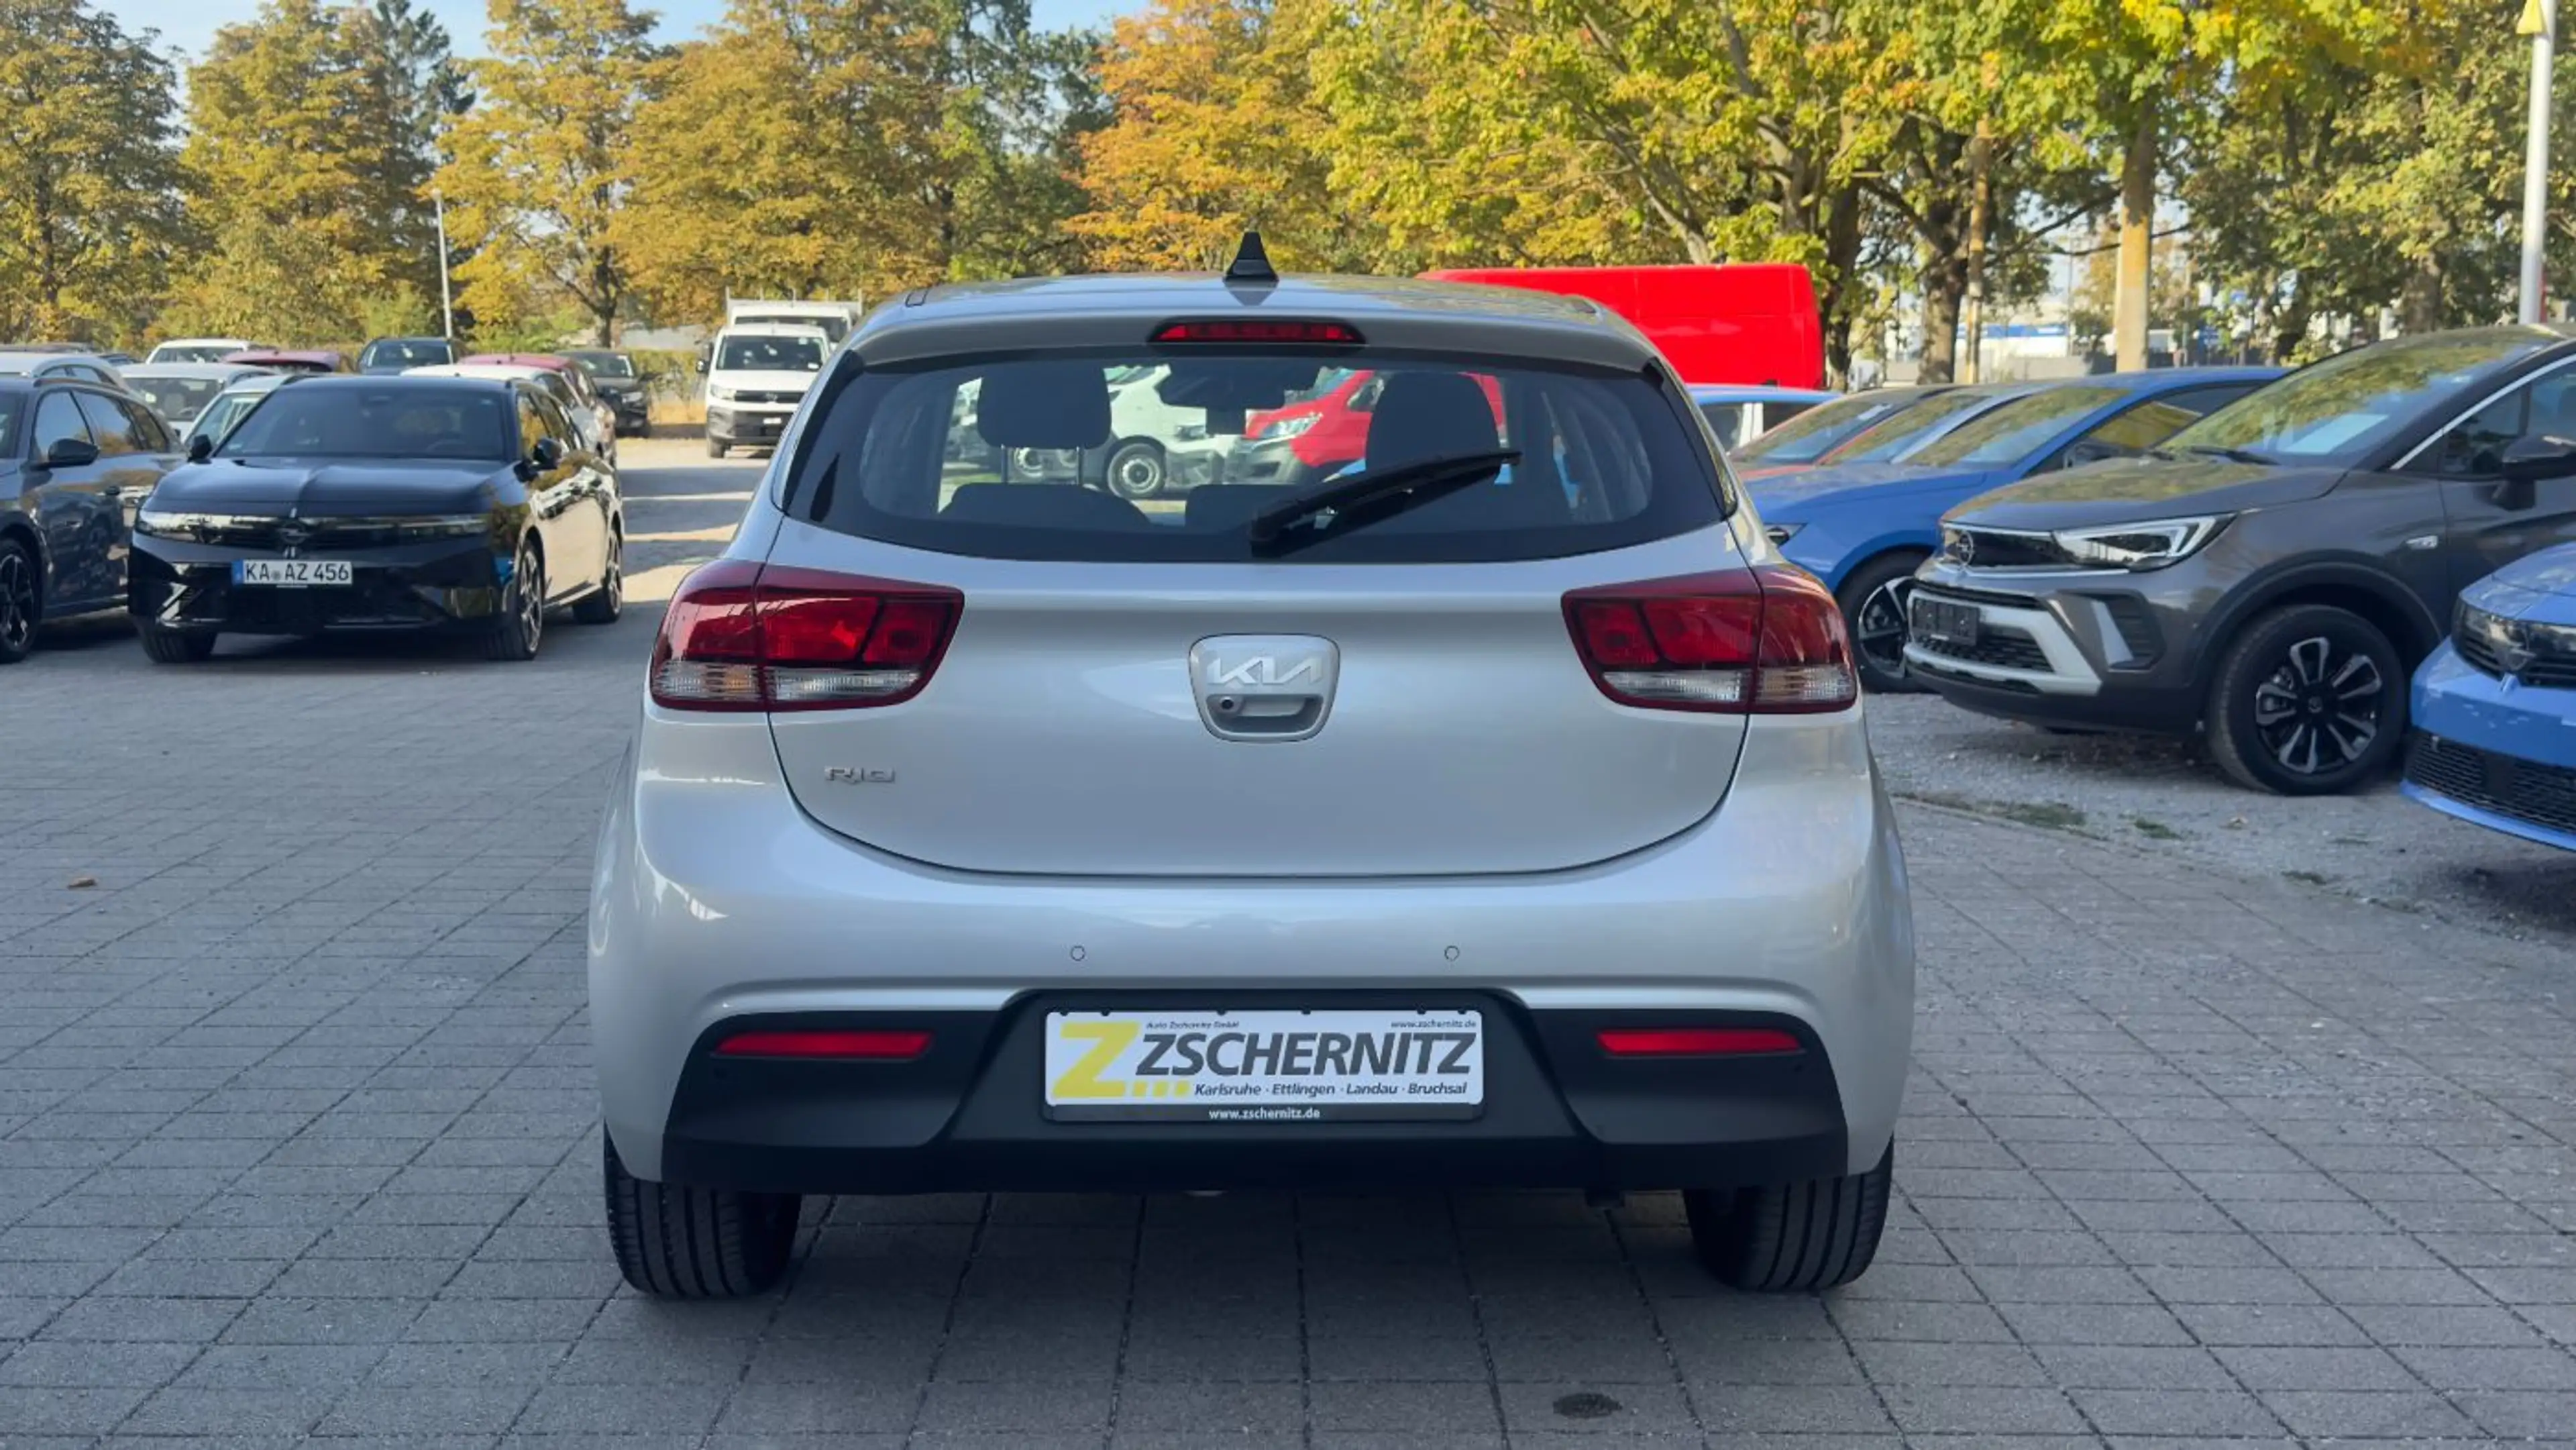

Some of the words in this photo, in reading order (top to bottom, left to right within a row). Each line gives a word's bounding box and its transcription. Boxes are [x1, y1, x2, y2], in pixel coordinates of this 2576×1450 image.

[246, 563, 270, 582] KA
[284, 563, 308, 582] AZ
[313, 563, 350, 582] 456
[1136, 1032, 1477, 1076] ZSCHERNITZ
[1194, 1082, 1262, 1096] Karlsruhe
[1272, 1082, 1336, 1098] Ettlingen
[1346, 1082, 1399, 1095] Landau
[1407, 1082, 1468, 1095] Bruchsal
[1208, 1106, 1321, 1120] www.zschernitz.de
